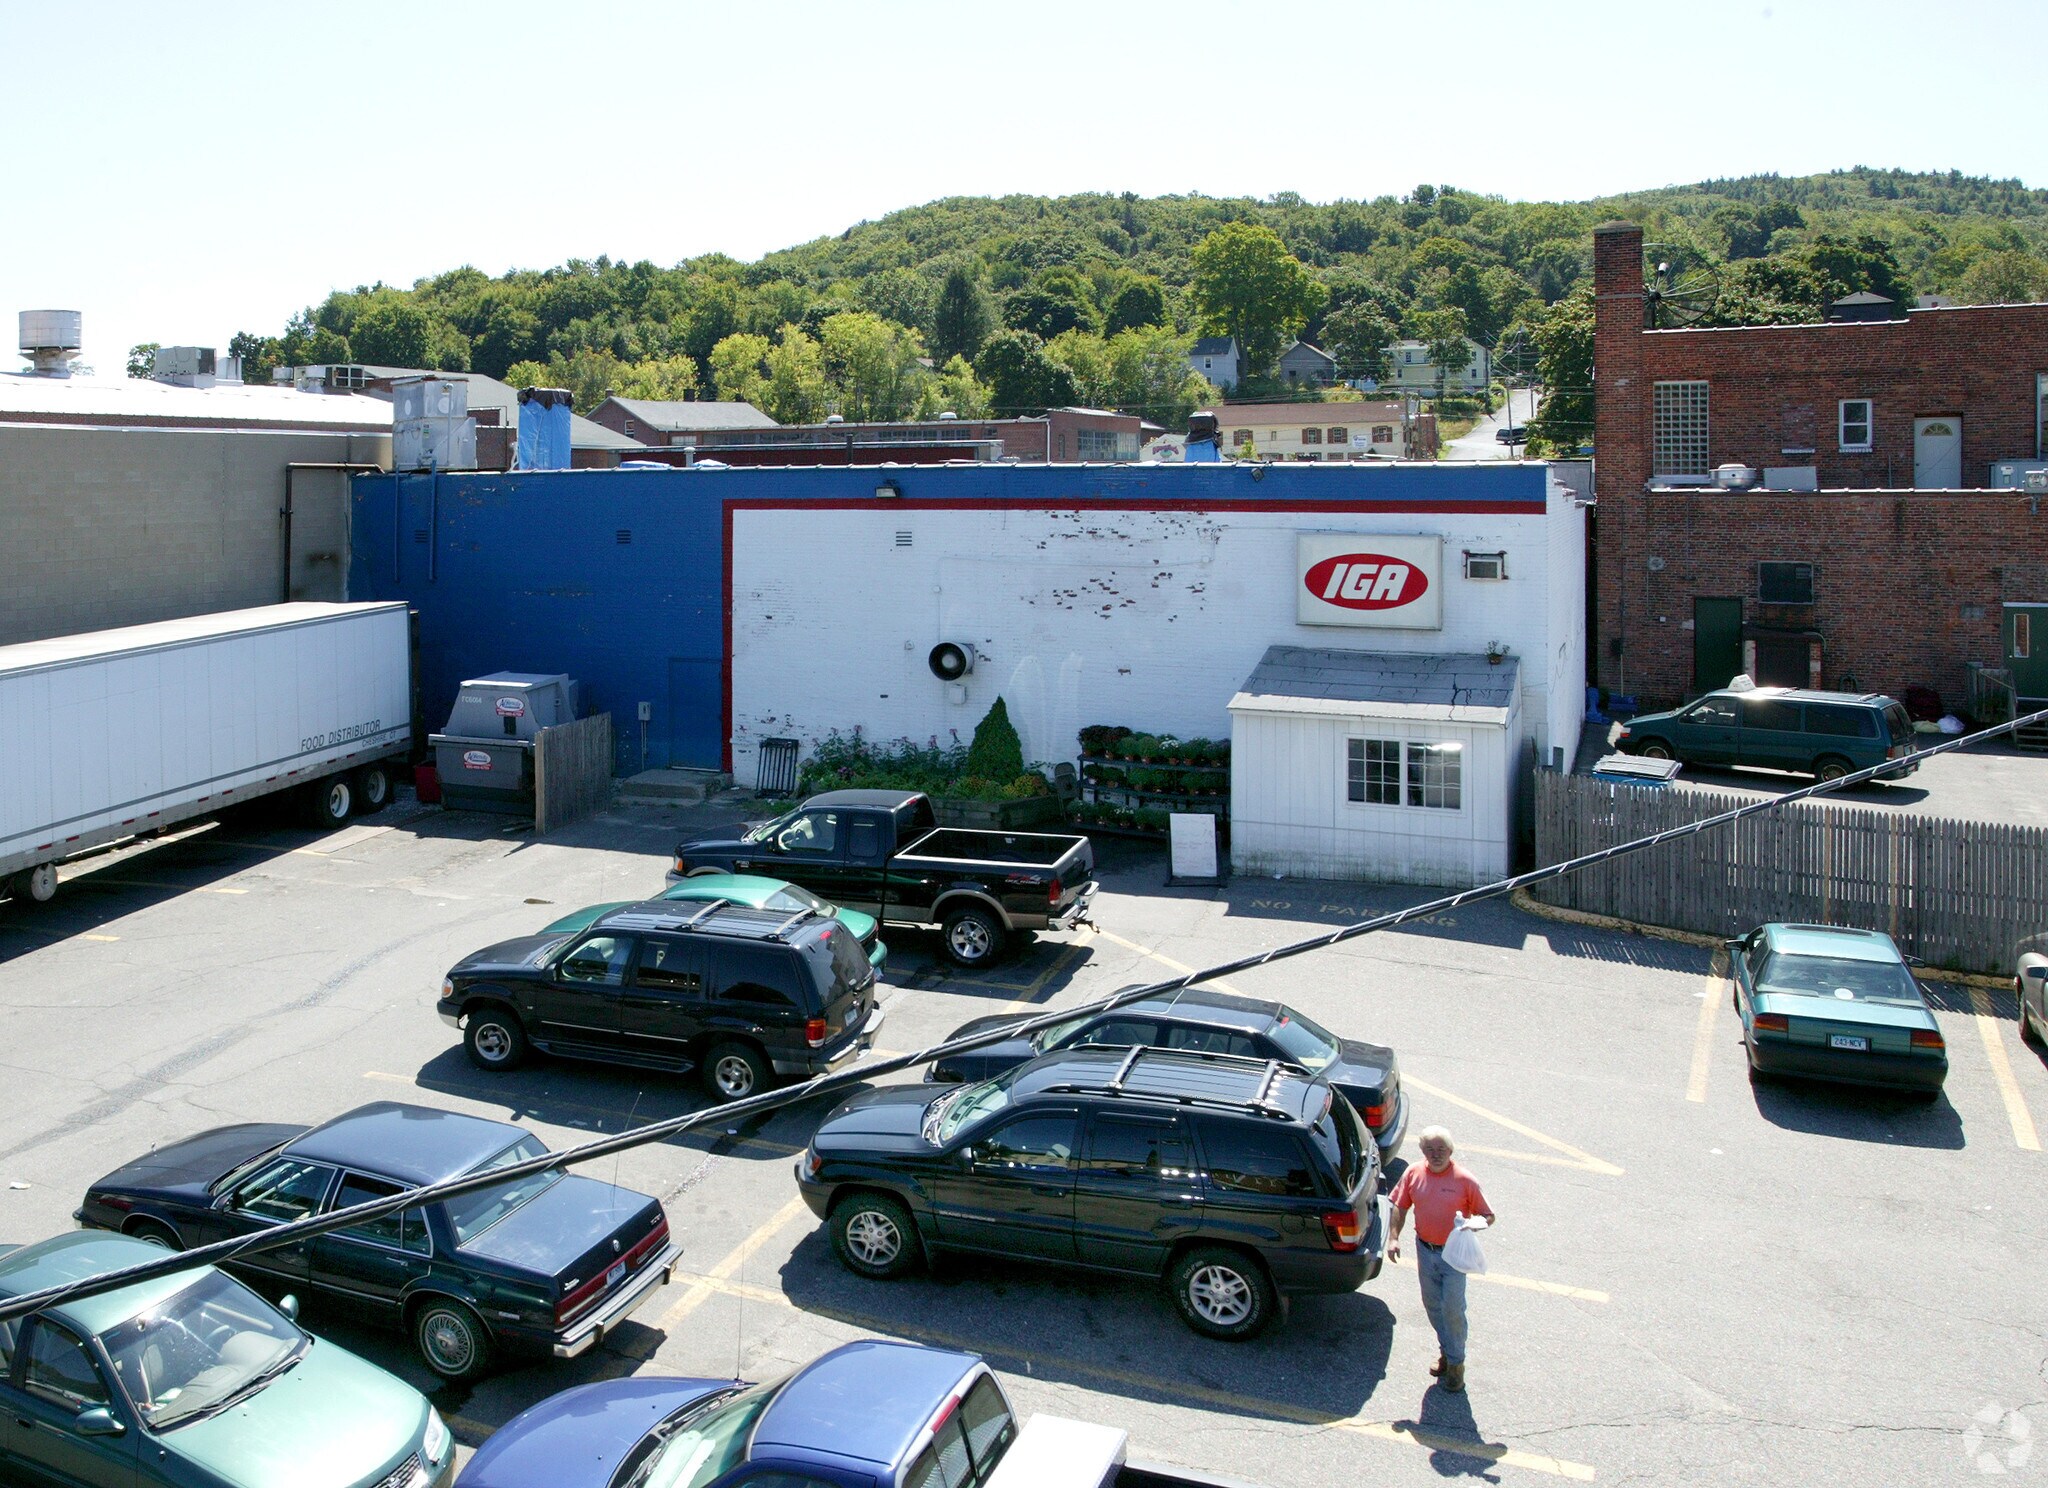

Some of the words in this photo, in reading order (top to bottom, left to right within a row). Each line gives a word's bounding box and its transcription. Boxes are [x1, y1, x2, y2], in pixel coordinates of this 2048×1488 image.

[1322, 563, 1410, 601] IGA
[300, 734, 325, 752] FOOD
[328, 719, 381, 744] DISTRIBUTOR
[1251, 900, 1292, 910] NO
[1319, 904, 1458, 926] PARNG
